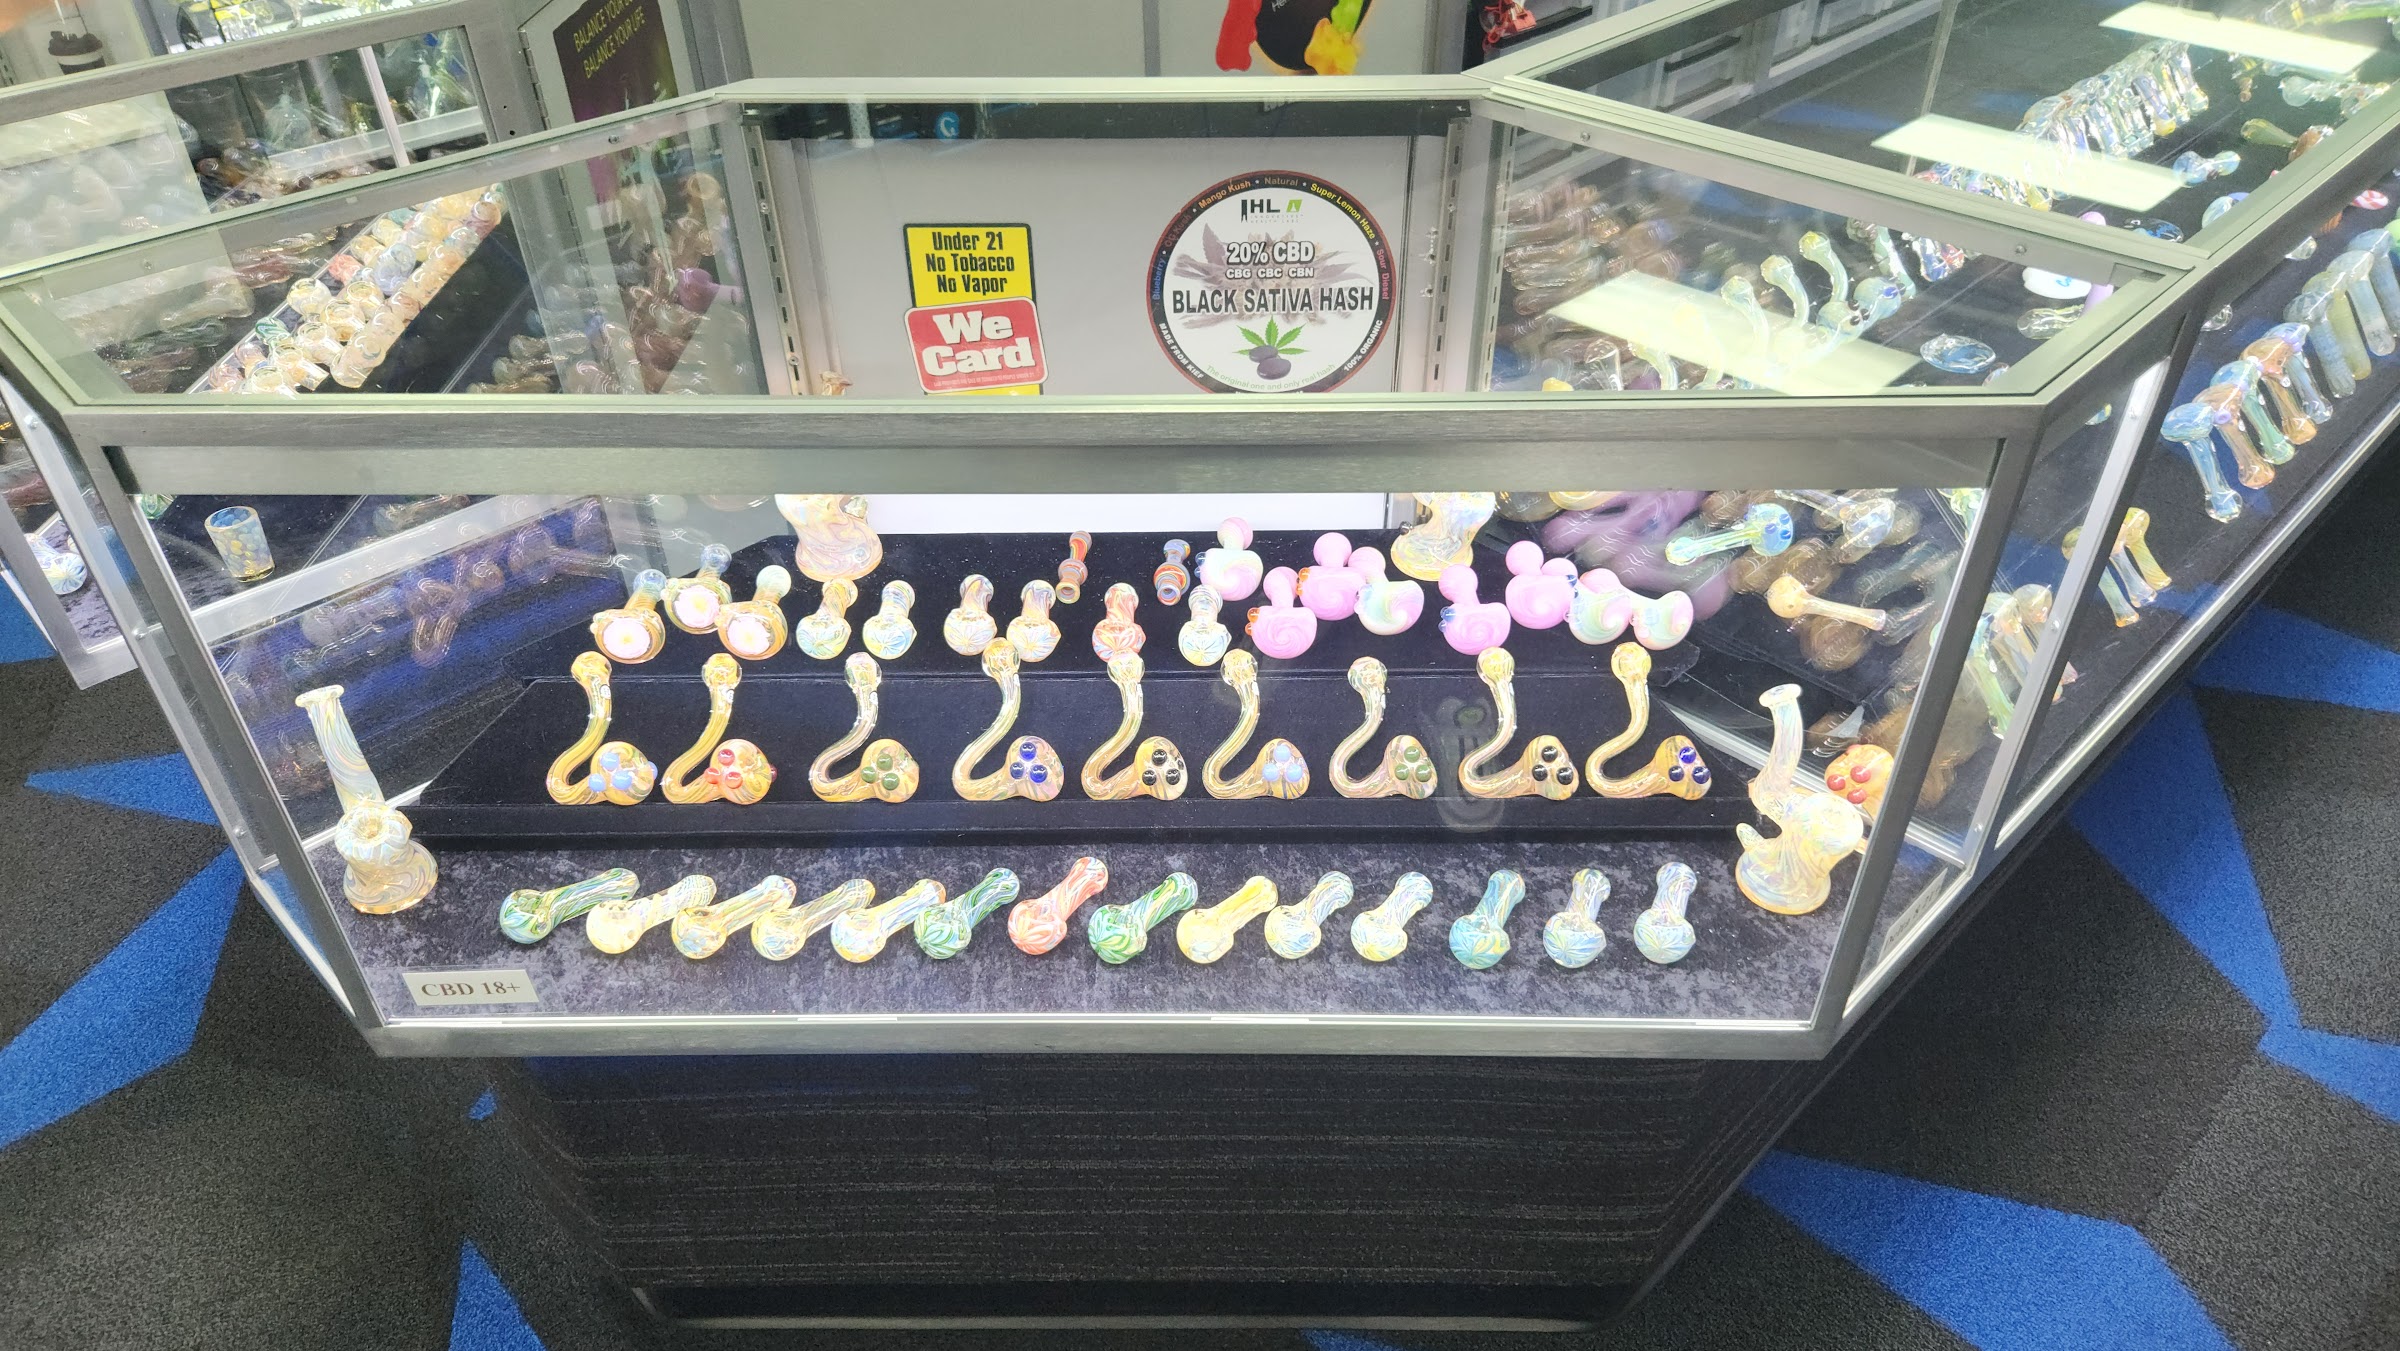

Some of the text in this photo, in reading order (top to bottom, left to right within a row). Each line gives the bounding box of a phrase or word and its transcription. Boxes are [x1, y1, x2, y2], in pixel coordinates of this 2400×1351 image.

[573, 8, 607, 53] BALANCE
[583, 6, 646, 79] BALANCE YOUR LIFE
[1227, 180, 1252, 193] Kush
[1264, 177, 1299, 187] Natural
[1310, 183, 1338, 200] Super
[1198, 188, 1228, 209] Mango
[1336, 196, 1362, 221] Lemon
[1173, 213, 1193, 236] Kush
[1359, 217, 1377, 240] Haze
[932, 231, 1004, 250] Under 21
[925, 253, 1015, 272] No Tobacco
[1227, 241, 1315, 265] 20% CBD
[1376, 248, 1388, 270] Sour
[1152, 257, 1167, 300] Blueberry
[1226, 267, 1315, 279] CBG CBC CBN
[937, 274, 1008, 296] No Vapor
[1381, 272, 1391, 301] Diesel
[1172, 286, 1374, 314] BLACK SATIVA HASH
[932, 310, 1014, 345] We
[922, 337, 1036, 376] Card
[1159, 322, 1204, 379] MADE FROM KIEF
[1343, 319, 1384, 372] 100% ORGANIC
[1206, 365, 1219, 378] The
[1220, 373, 1250, 388] original
[1267, 382, 1282, 391] and
[1283, 377, 1301, 389] only
[1301, 372, 1317, 384] real
[1316, 363, 1336, 378] hash
[421, 981, 521, 997] CBD 18+
